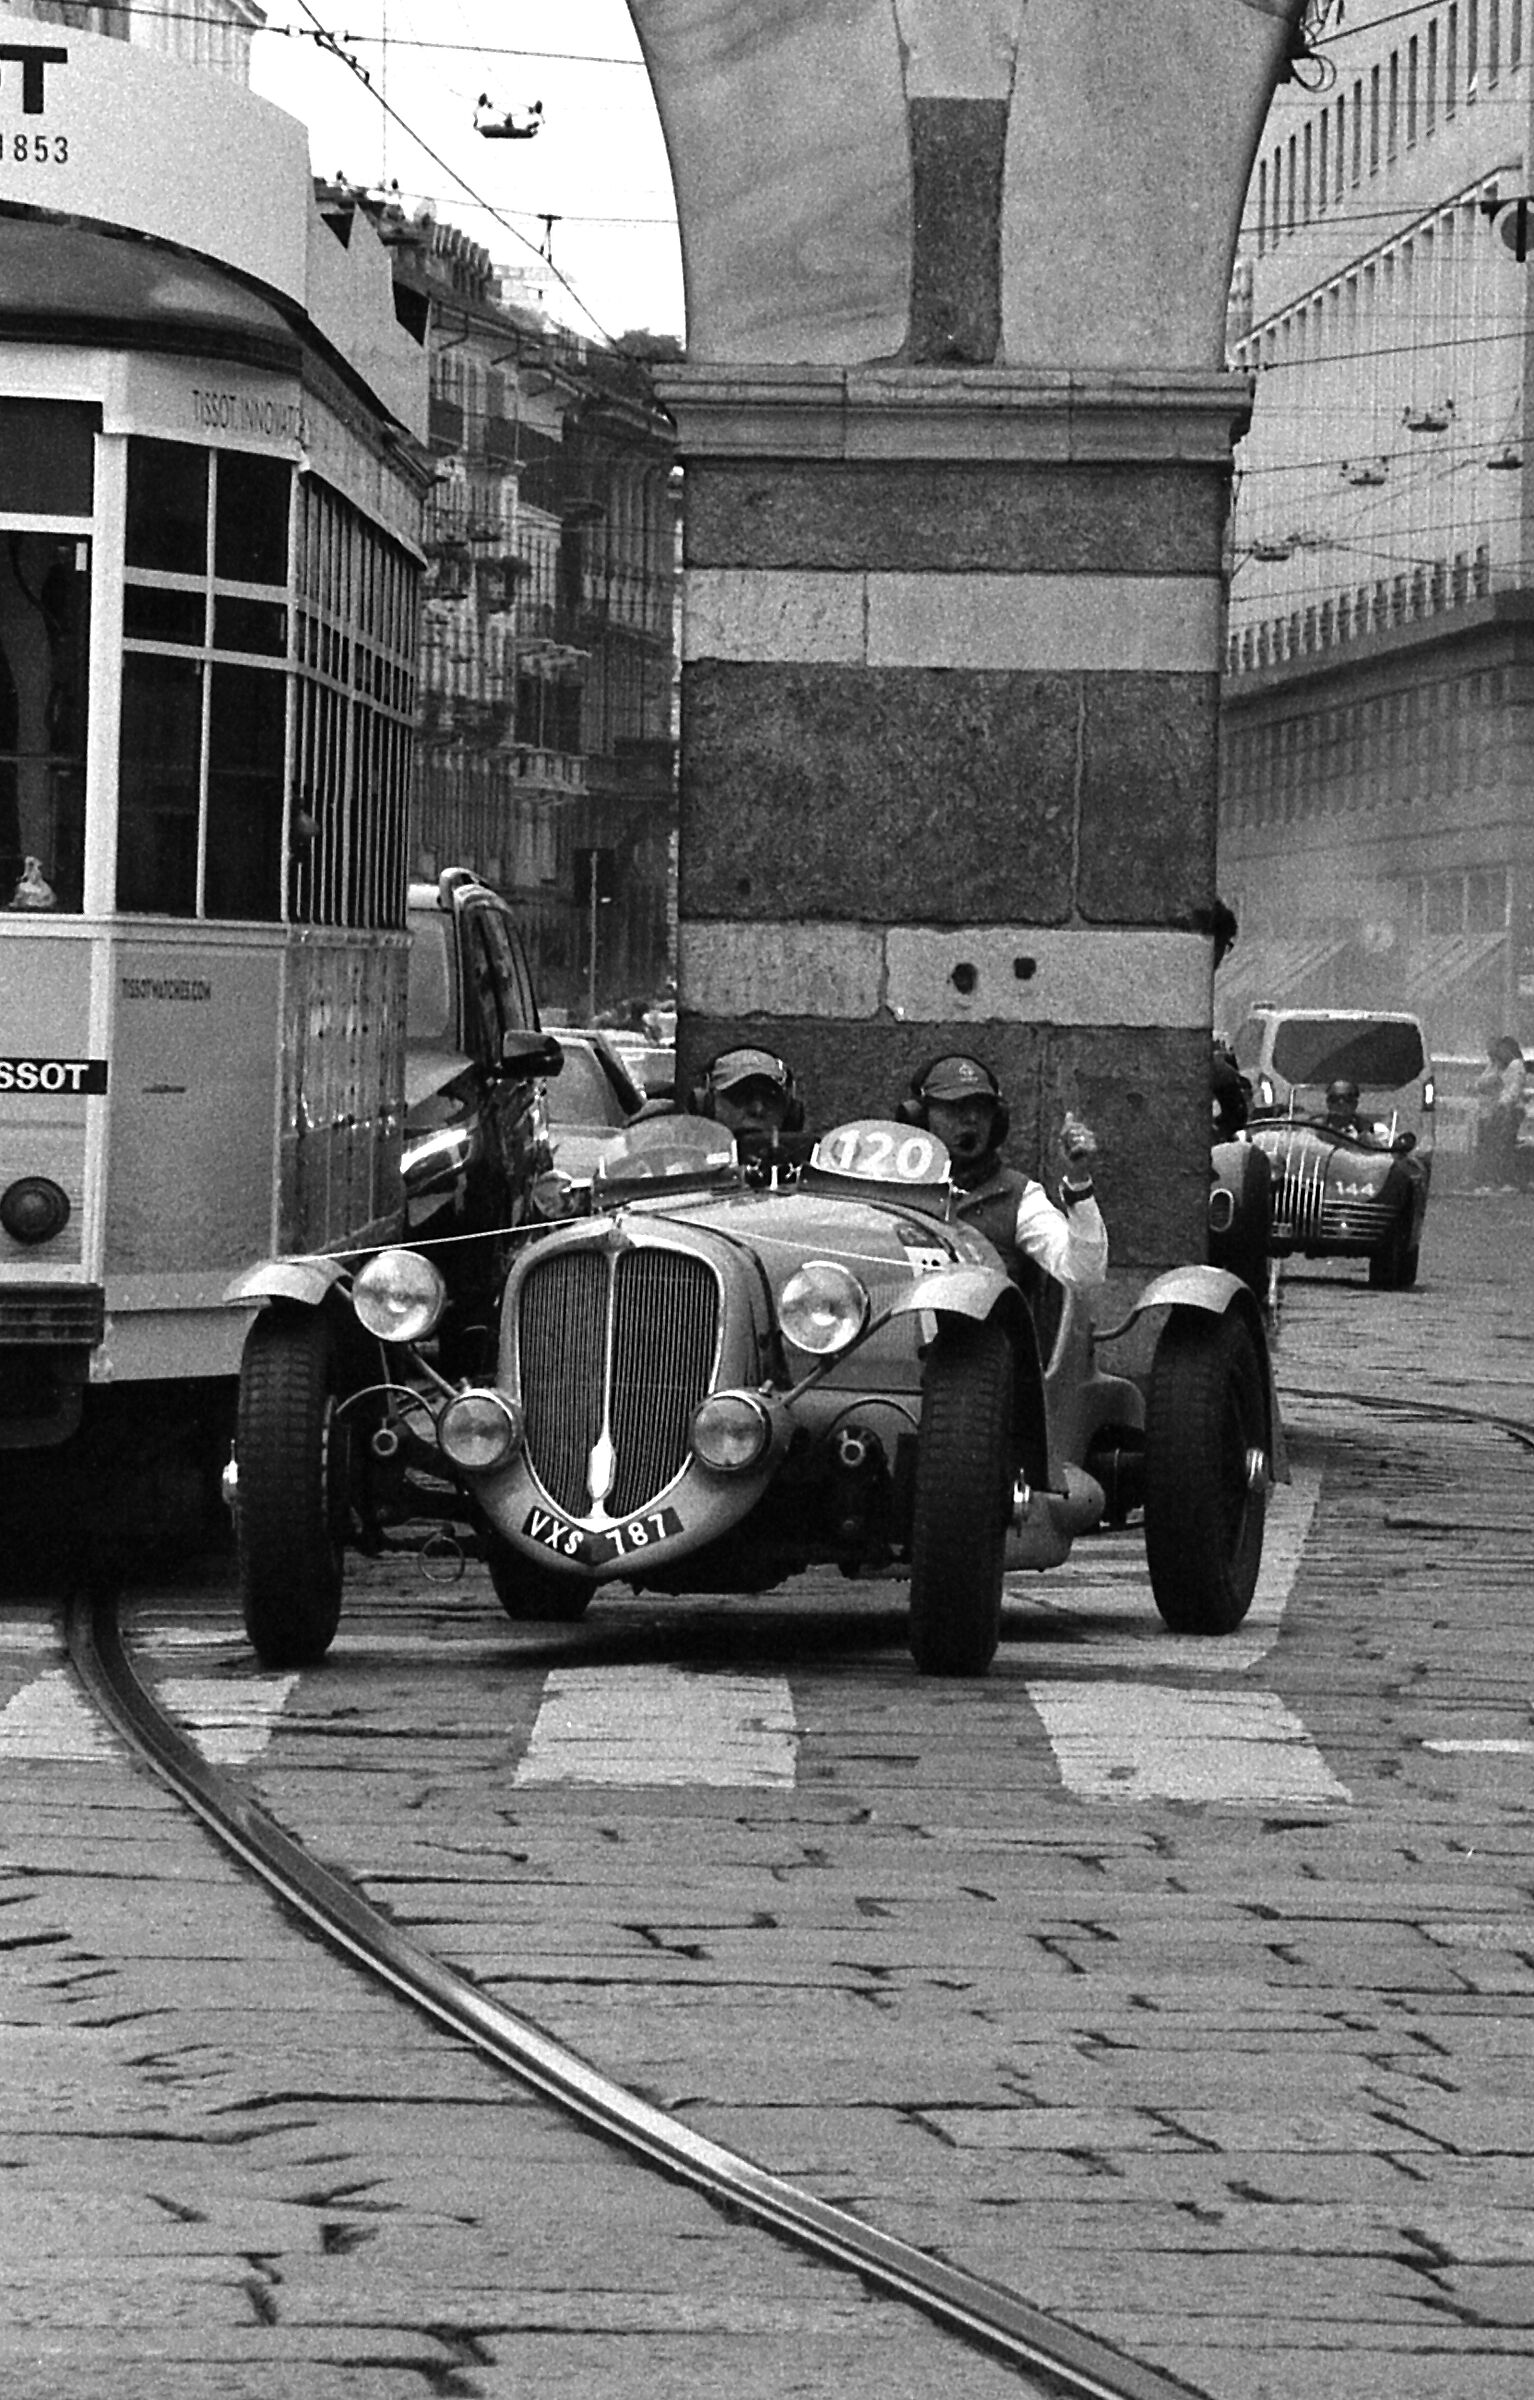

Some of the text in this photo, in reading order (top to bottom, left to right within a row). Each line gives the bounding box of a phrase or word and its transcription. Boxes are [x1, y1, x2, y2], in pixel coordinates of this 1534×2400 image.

[0, 133, 68, 163] 853
[0, 1061, 89, 1090] SSOT
[839, 1129, 933, 1178] 120
[1335, 1181, 1376, 1198] 144
[530, 1503, 666, 1555] VXS 787
